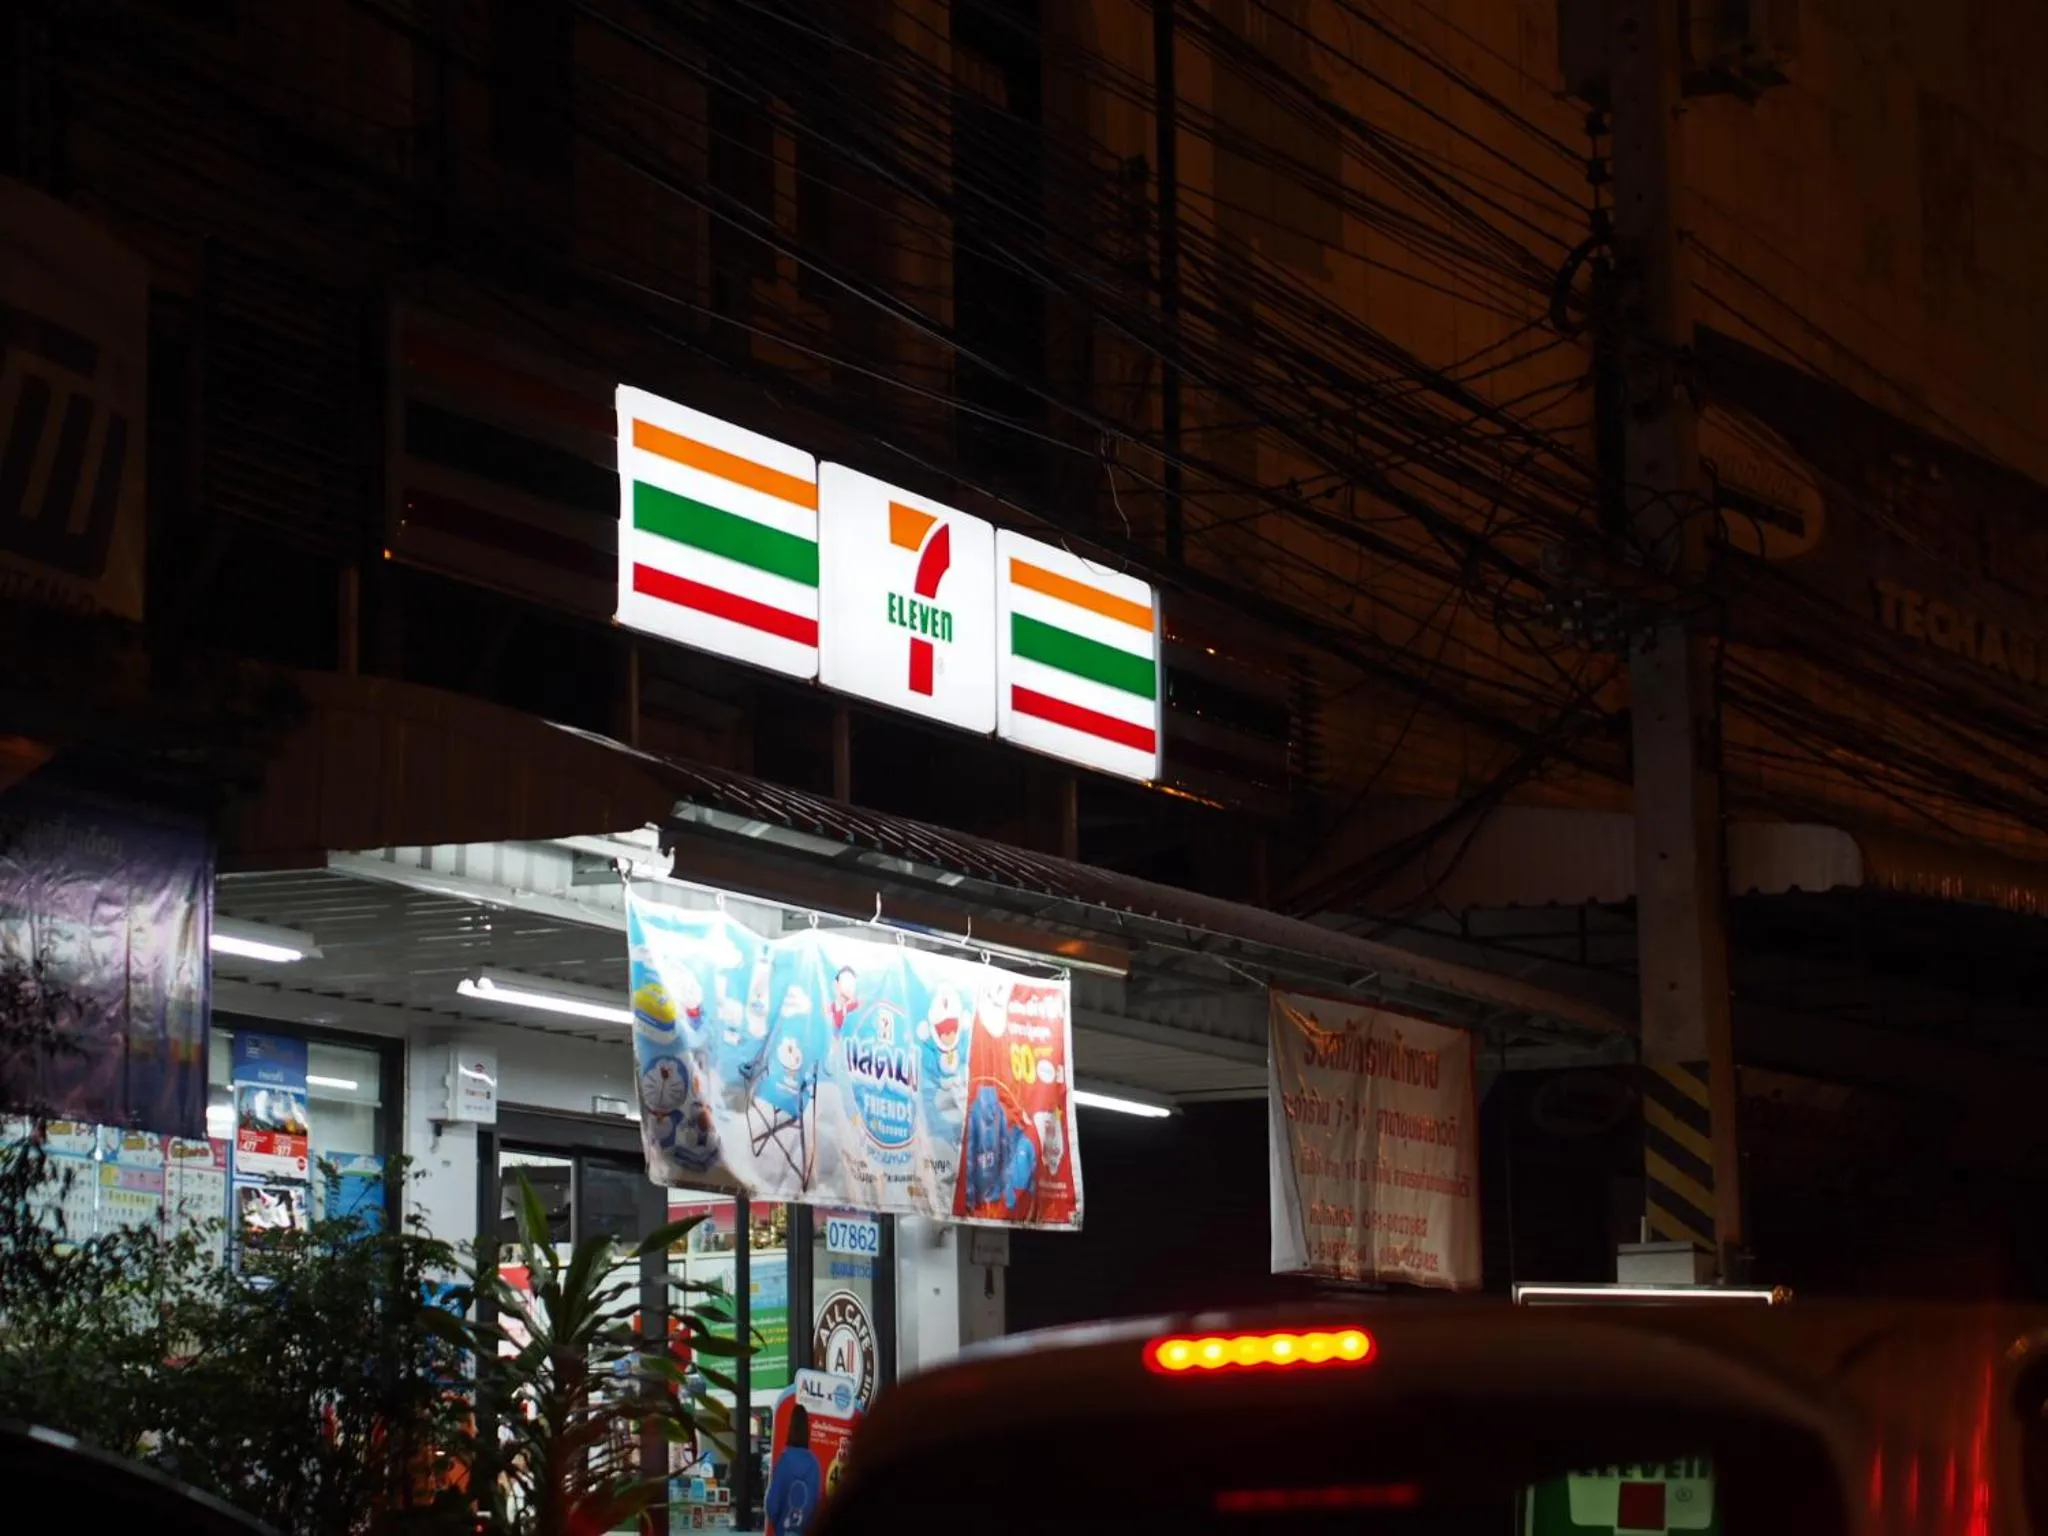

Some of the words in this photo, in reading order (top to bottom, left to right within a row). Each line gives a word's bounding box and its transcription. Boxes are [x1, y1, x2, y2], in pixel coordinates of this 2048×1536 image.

[889, 501, 950, 697] 7
[829, 1221, 877, 1252] 07862
[819, 1303, 844, 1348] ALL
[799, 1378, 824, 1398] ALL
